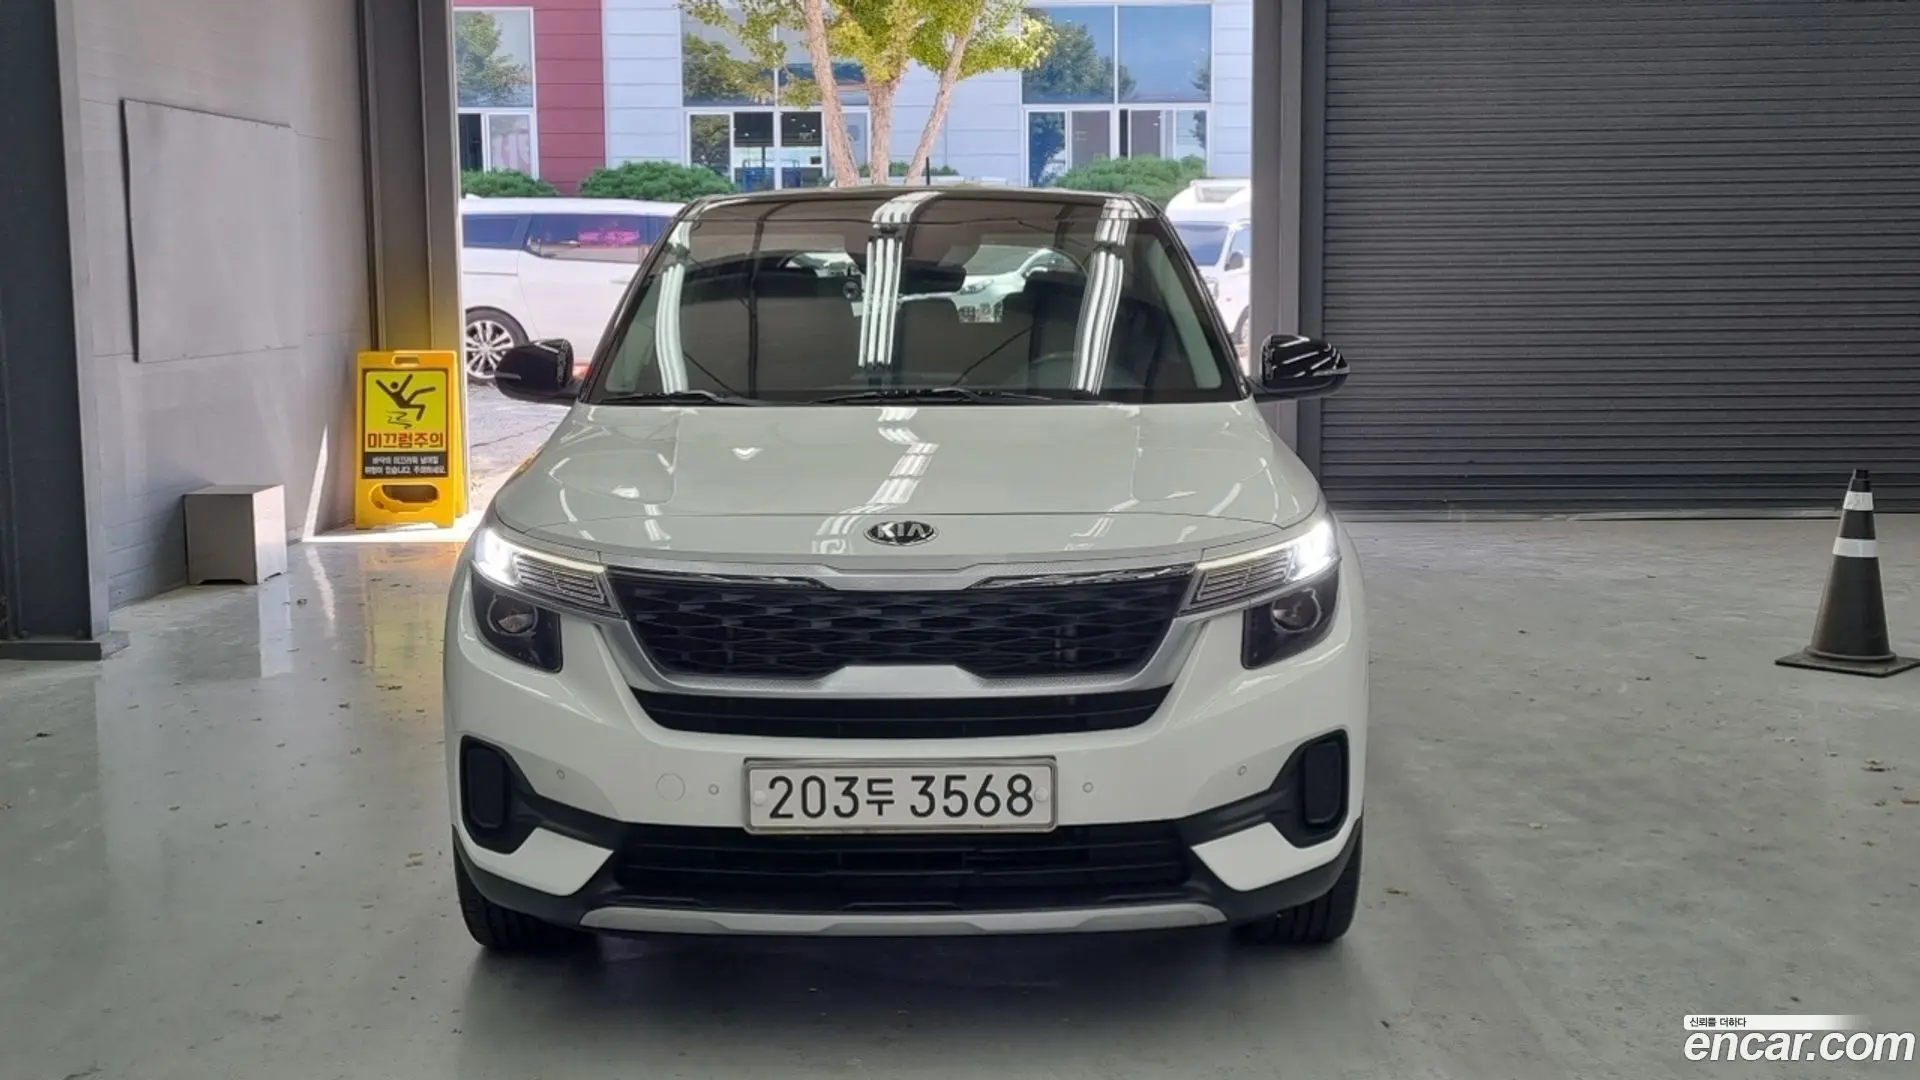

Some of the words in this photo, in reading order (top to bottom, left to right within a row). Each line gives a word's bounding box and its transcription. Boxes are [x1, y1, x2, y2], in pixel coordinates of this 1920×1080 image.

[367, 433, 444, 448] 미끄럼주의
[877, 522, 926, 538] KIA
[769, 775, 895, 819] 203두
[910, 773, 1034, 818] 3568
